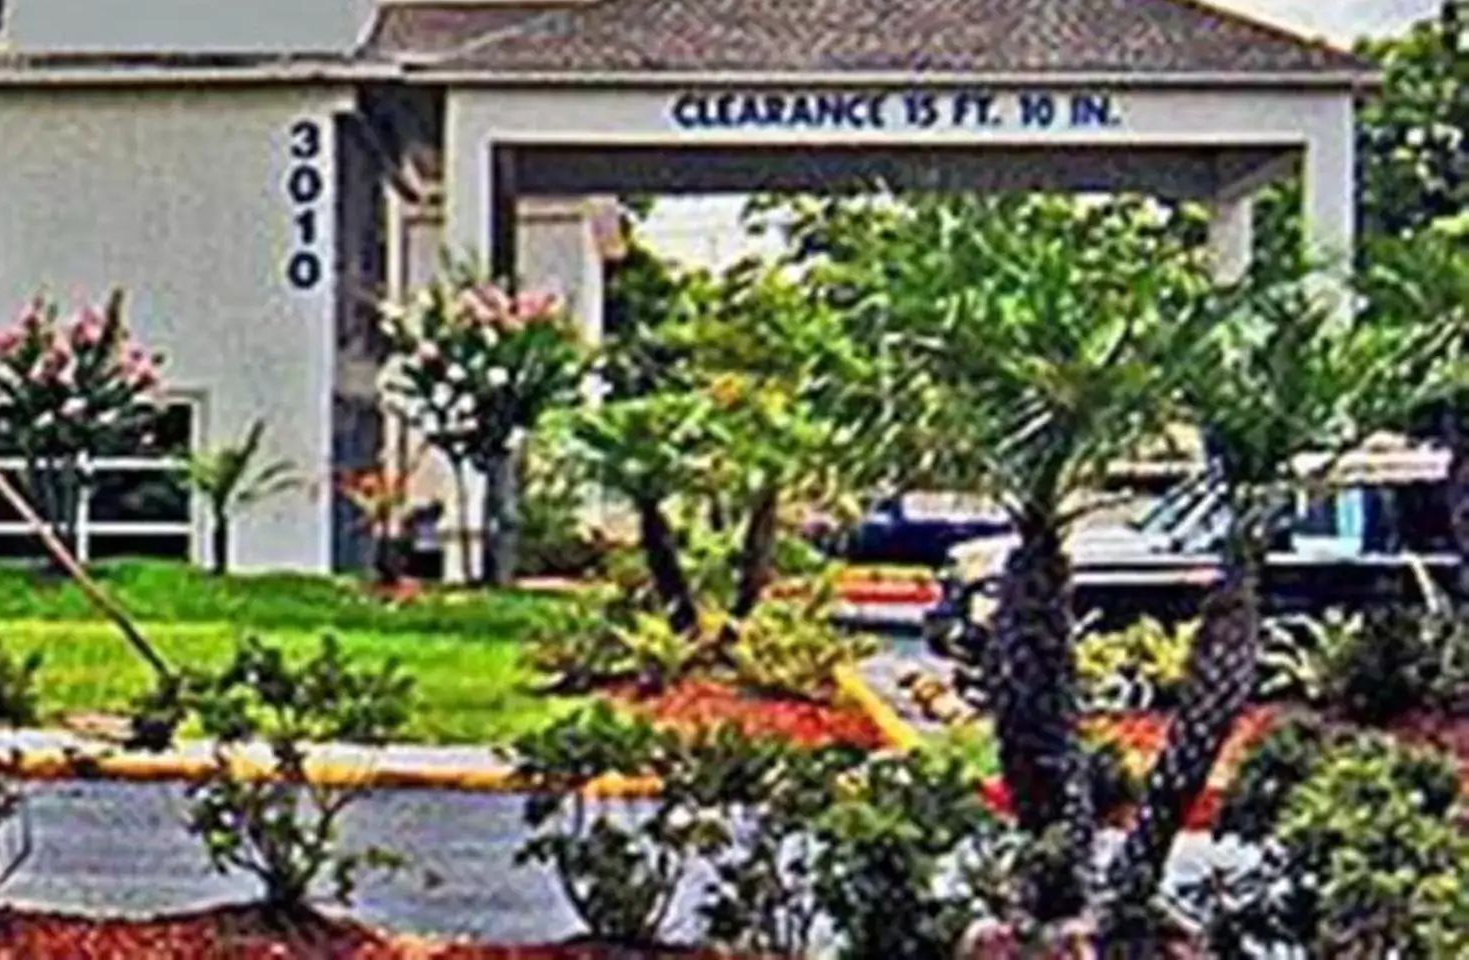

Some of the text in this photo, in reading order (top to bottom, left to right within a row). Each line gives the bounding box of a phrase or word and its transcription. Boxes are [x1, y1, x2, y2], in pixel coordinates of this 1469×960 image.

[673, 93, 1122, 128] CLEARANCE 15 FT. 10 IN.
[287, 120, 322, 289] 3010
